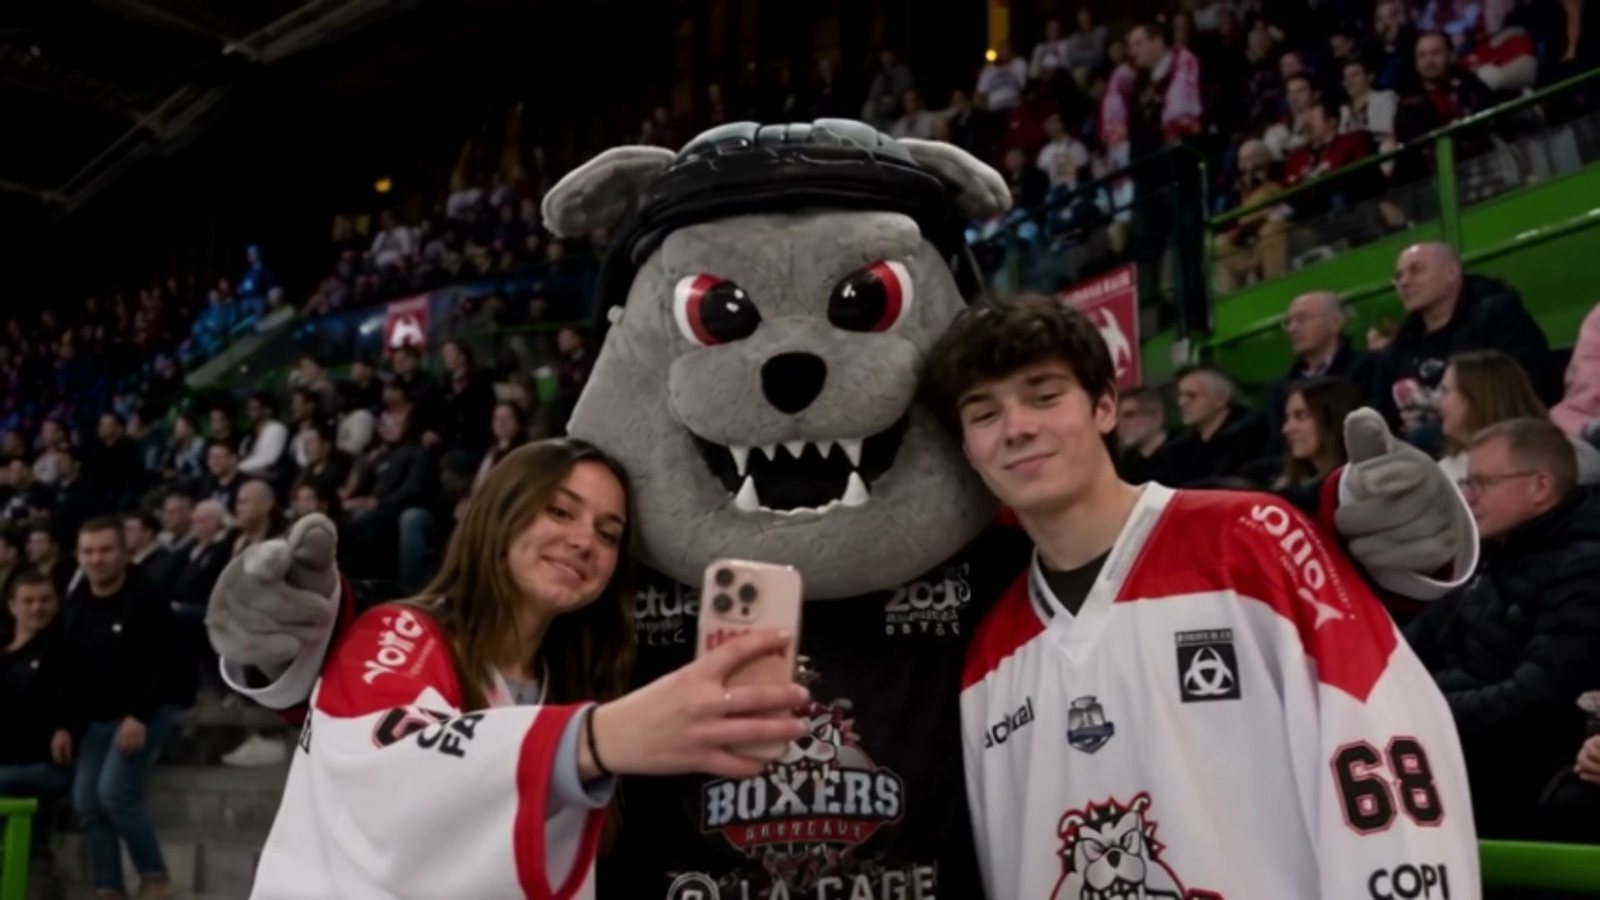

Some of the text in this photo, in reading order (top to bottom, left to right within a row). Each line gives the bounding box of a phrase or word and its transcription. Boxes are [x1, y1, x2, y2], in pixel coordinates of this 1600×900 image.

[707, 771, 902, 826] BOXERS
[1330, 736, 1444, 835] 68
[816, 865, 937, 900] CAGE
